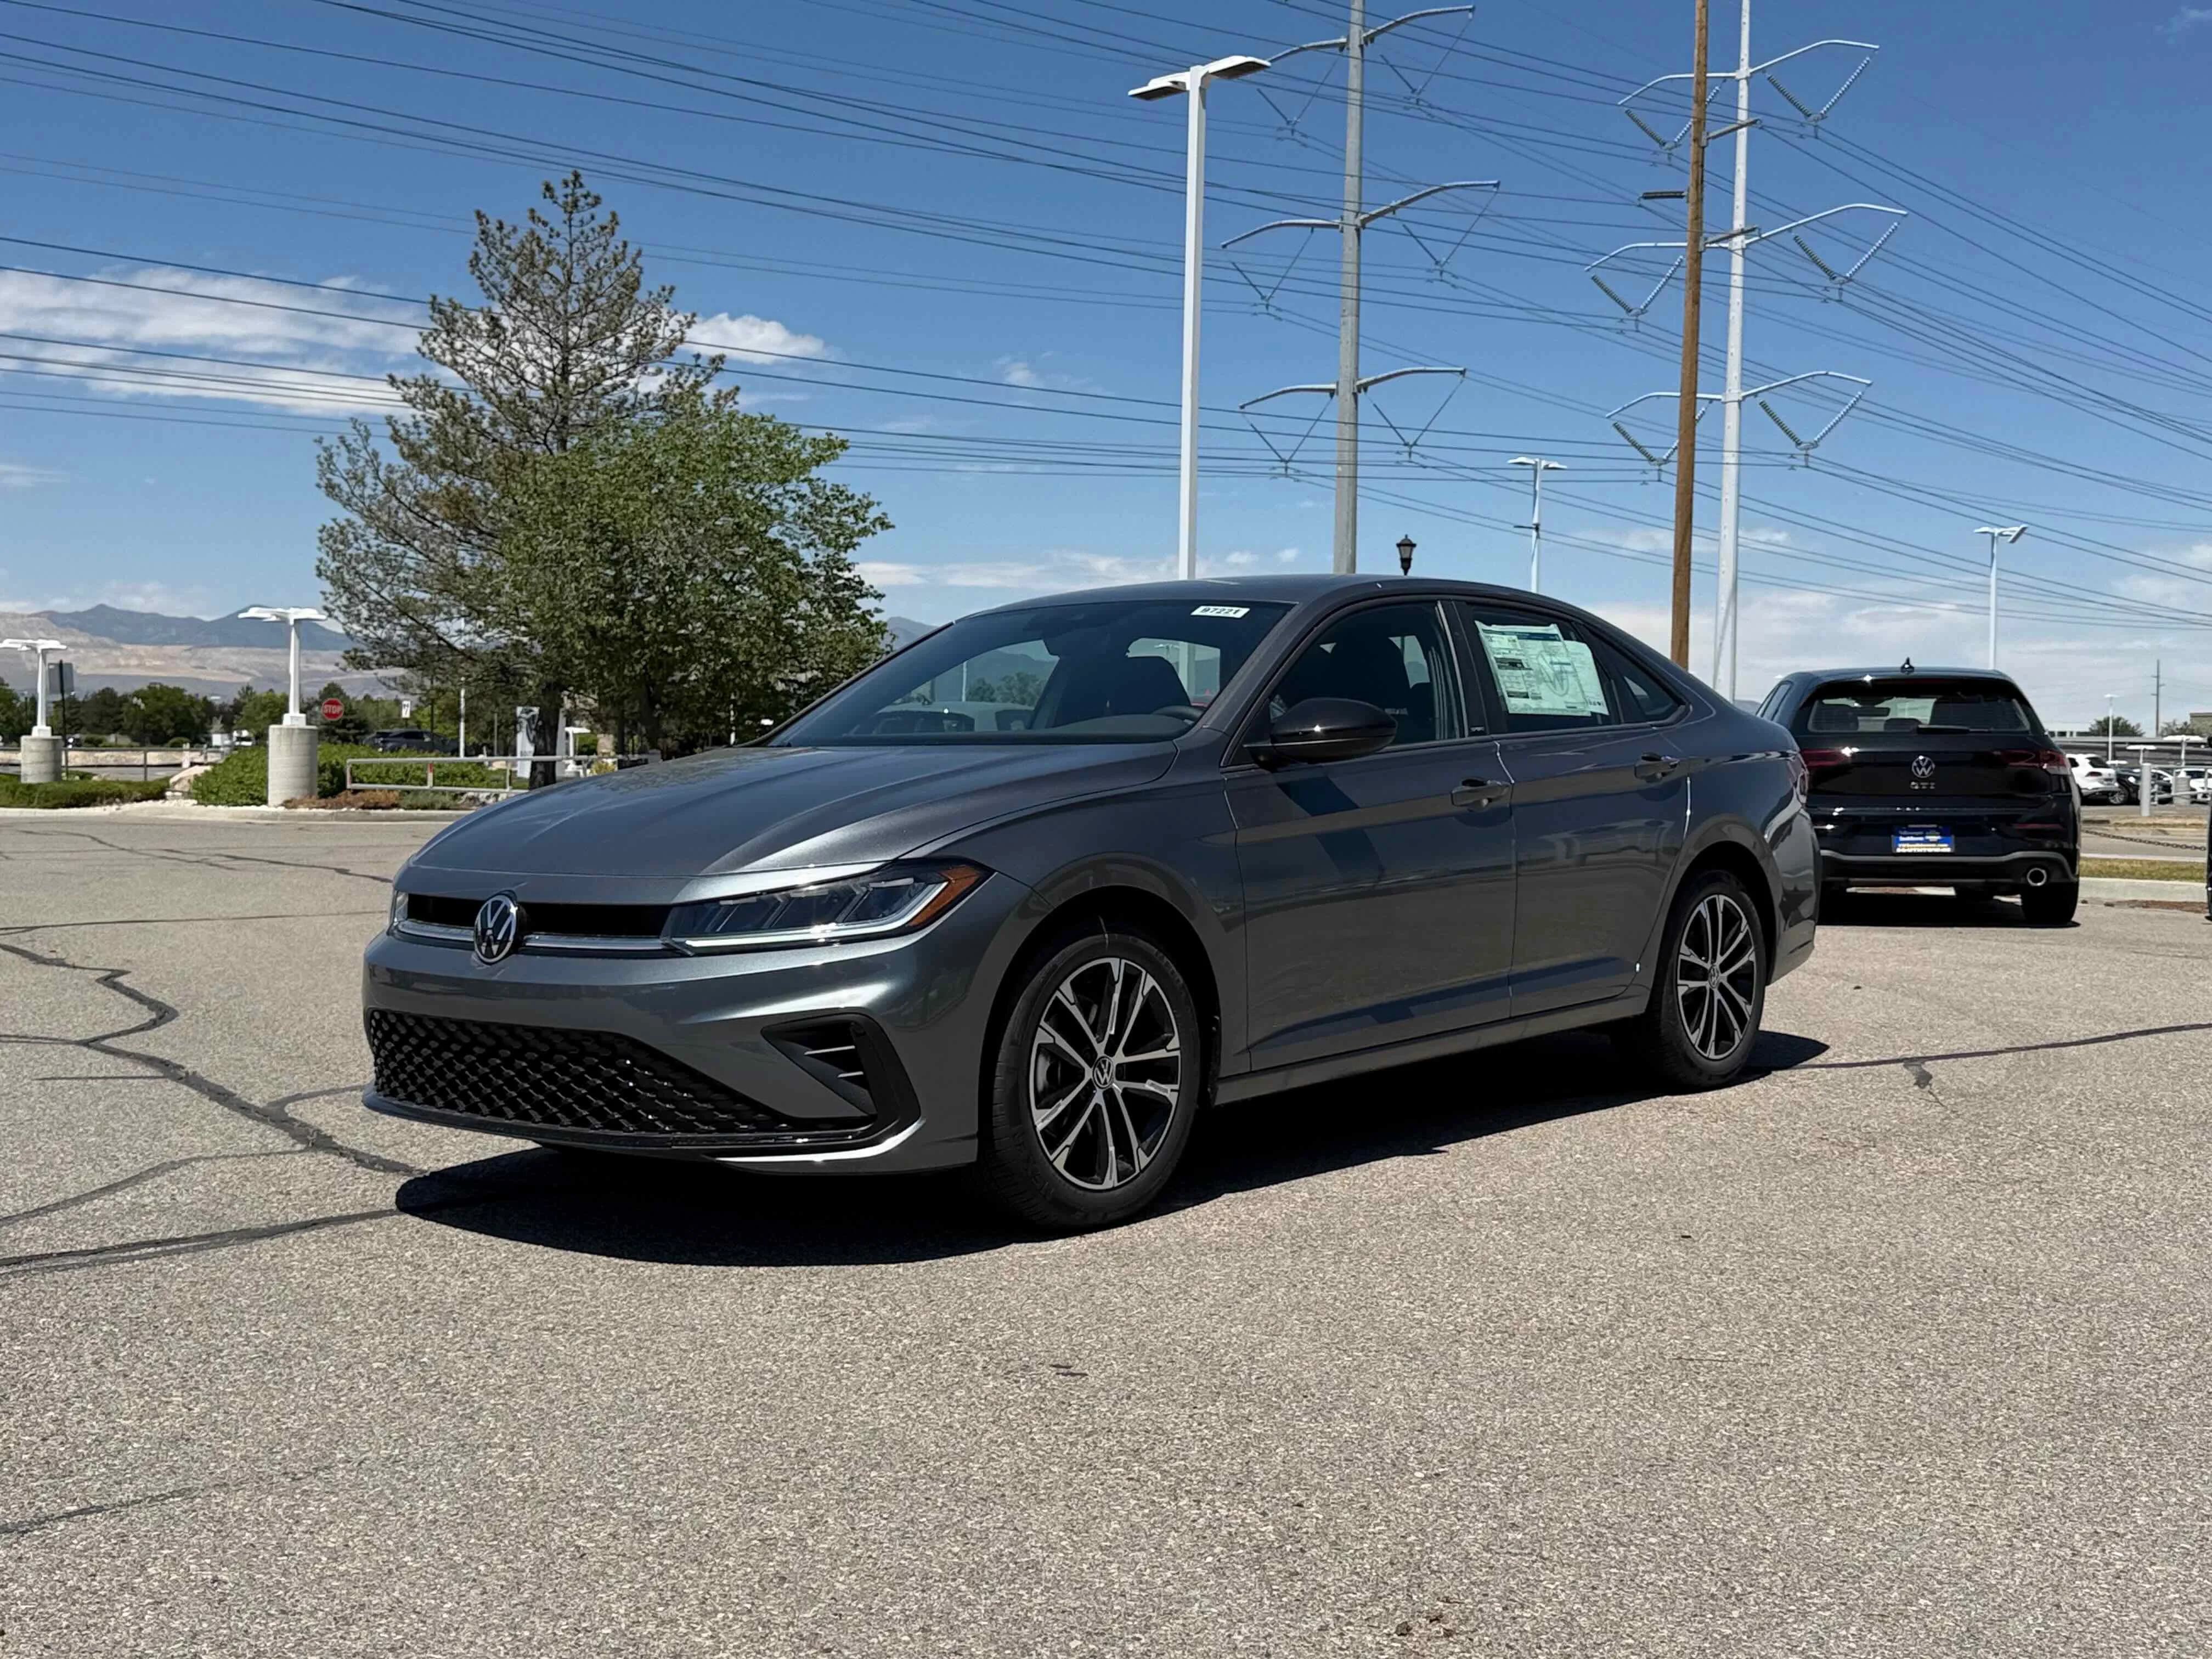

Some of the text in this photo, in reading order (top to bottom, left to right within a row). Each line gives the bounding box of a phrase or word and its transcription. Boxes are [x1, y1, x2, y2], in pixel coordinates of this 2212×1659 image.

[324, 704, 342, 714] STOP
[1912, 755, 1935, 778] VW
[475, 895, 516, 962] VW
[1094, 1058, 1113, 1087] VW
